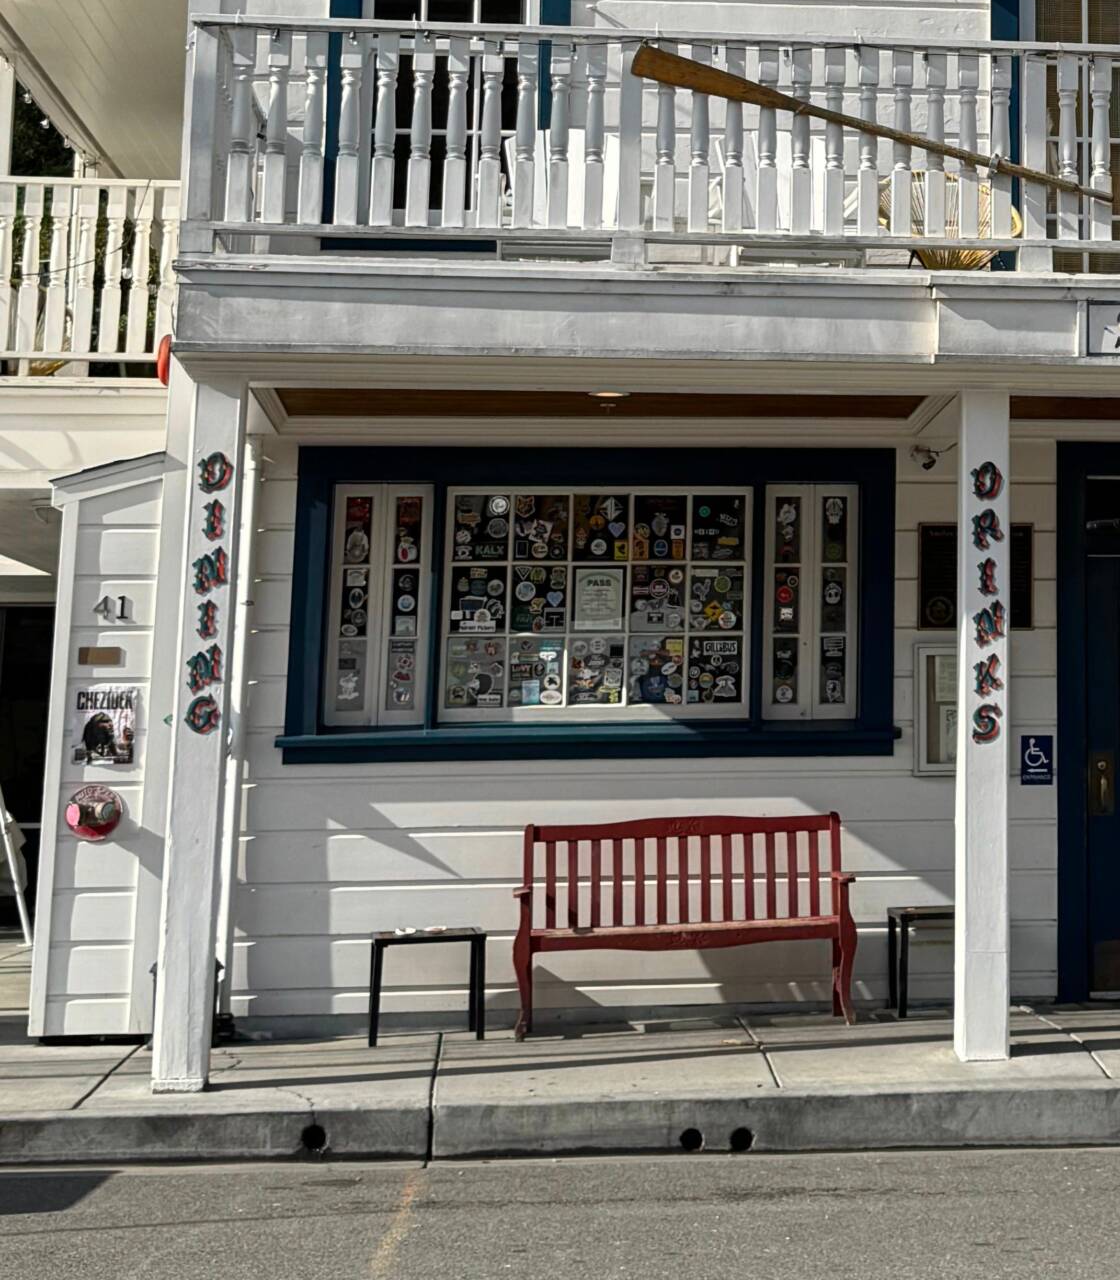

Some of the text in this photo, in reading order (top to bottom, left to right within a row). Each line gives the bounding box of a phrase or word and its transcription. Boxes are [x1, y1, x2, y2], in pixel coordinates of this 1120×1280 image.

[93, 595, 129, 620] 41
[184, 451, 234, 736] DINING
[586, 578, 612, 587] PASS
[971, 461, 1004, 745] DRINKS
